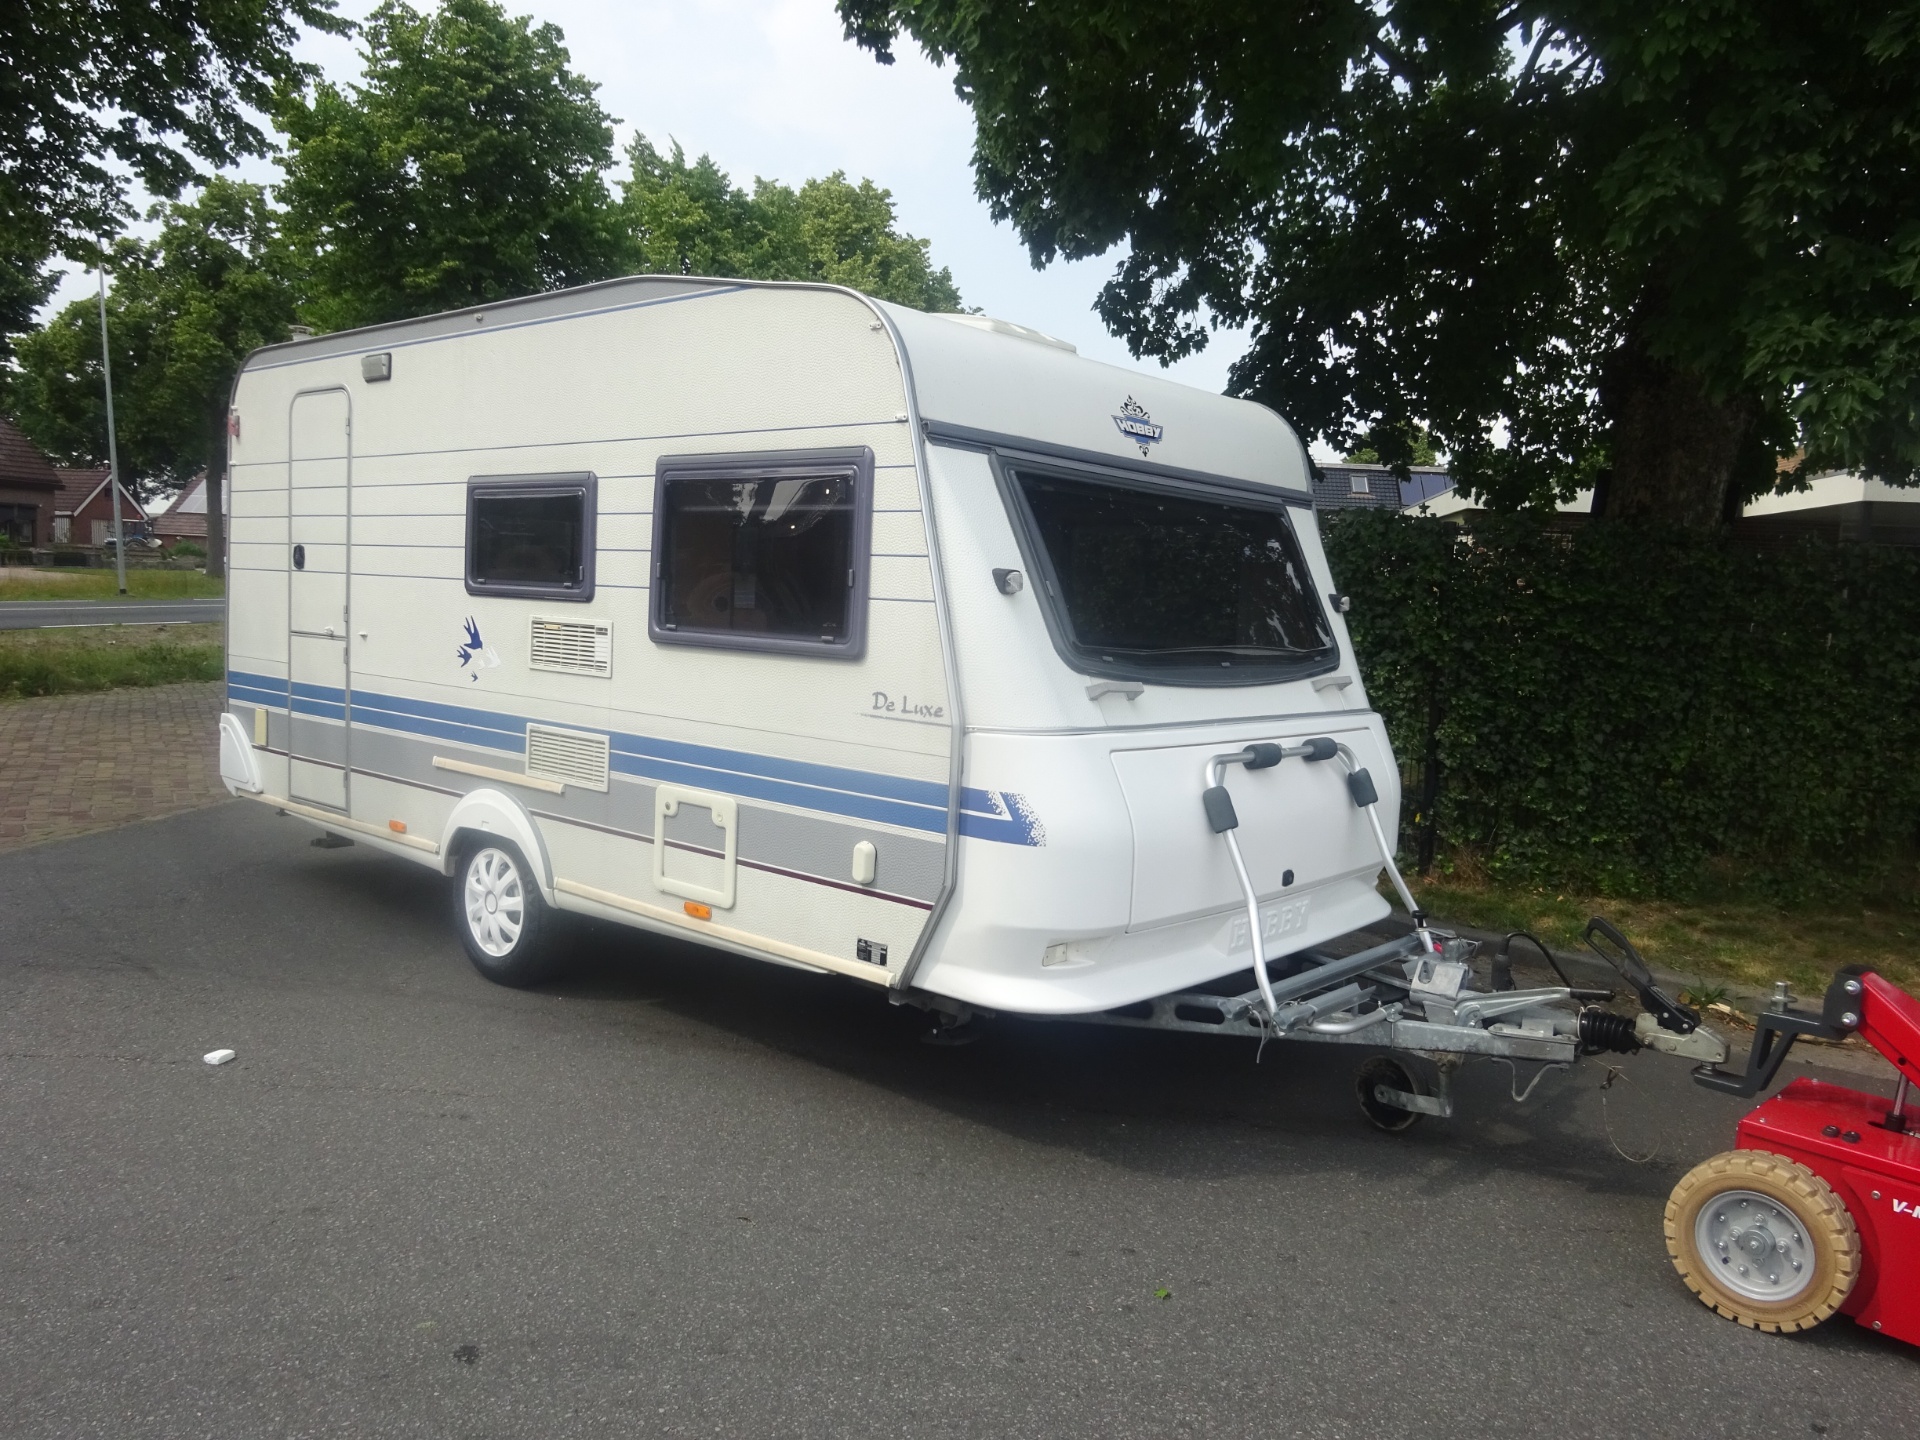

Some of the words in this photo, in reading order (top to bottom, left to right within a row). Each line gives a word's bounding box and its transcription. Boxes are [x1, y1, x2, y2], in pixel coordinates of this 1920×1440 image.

[1116, 418, 1161, 438] HOBBY
[872, 691, 895, 712] De
[901, 695, 944, 717] Luxe
[1230, 900, 1309, 949] HBBY
